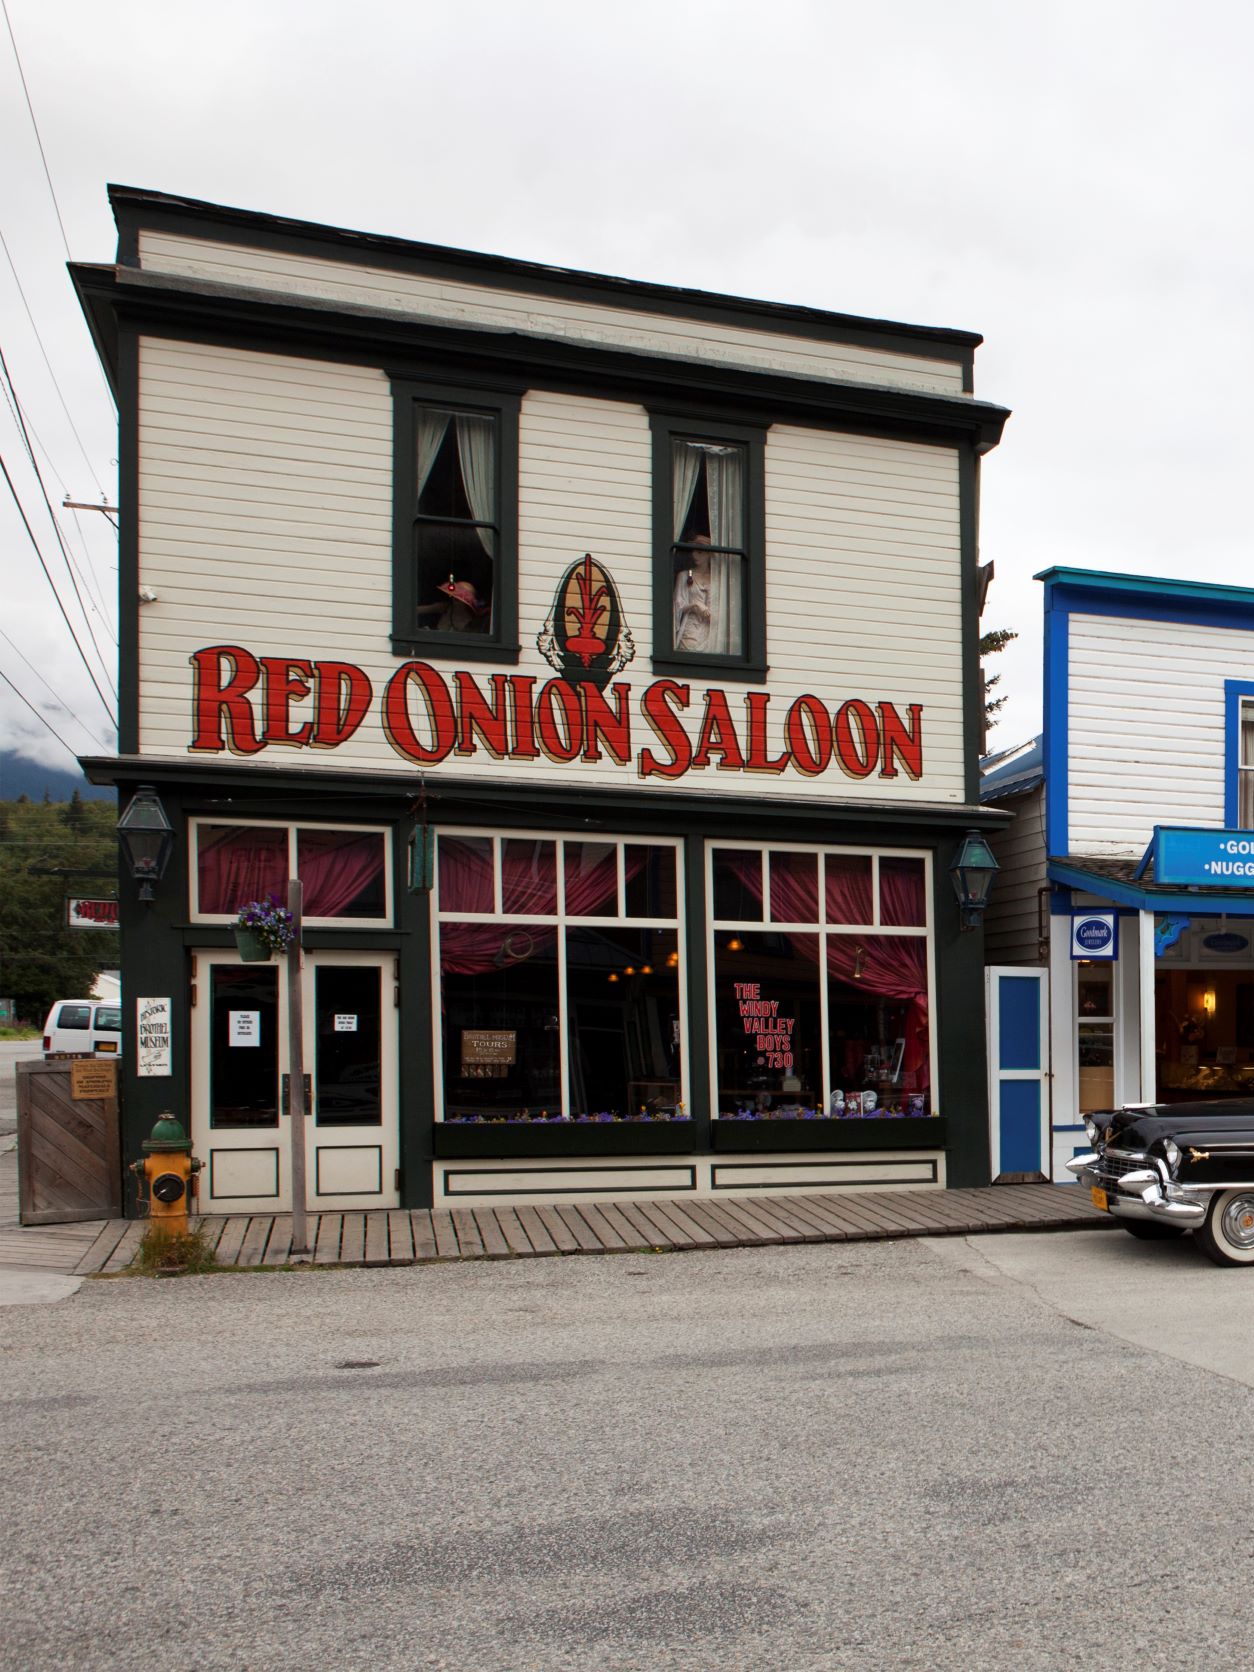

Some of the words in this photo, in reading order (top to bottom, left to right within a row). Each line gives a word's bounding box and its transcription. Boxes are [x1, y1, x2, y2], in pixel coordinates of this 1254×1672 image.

[187, 645, 373, 756] RED
[381, 661, 632, 767] ONION
[637, 679, 923, 781] SALOON
[1080, 926, 1108, 938] Goodmark
[734, 983, 760, 999] THE
[739, 1000, 779, 1017] WINDY
[744, 1018, 795, 1034] VALLEY
[140, 1036, 169, 1048] MUSEUM
[471, 1040, 508, 1048] TOURS
[757, 1035, 791, 1051] BOYS
[766, 1052, 793, 1068] 730
